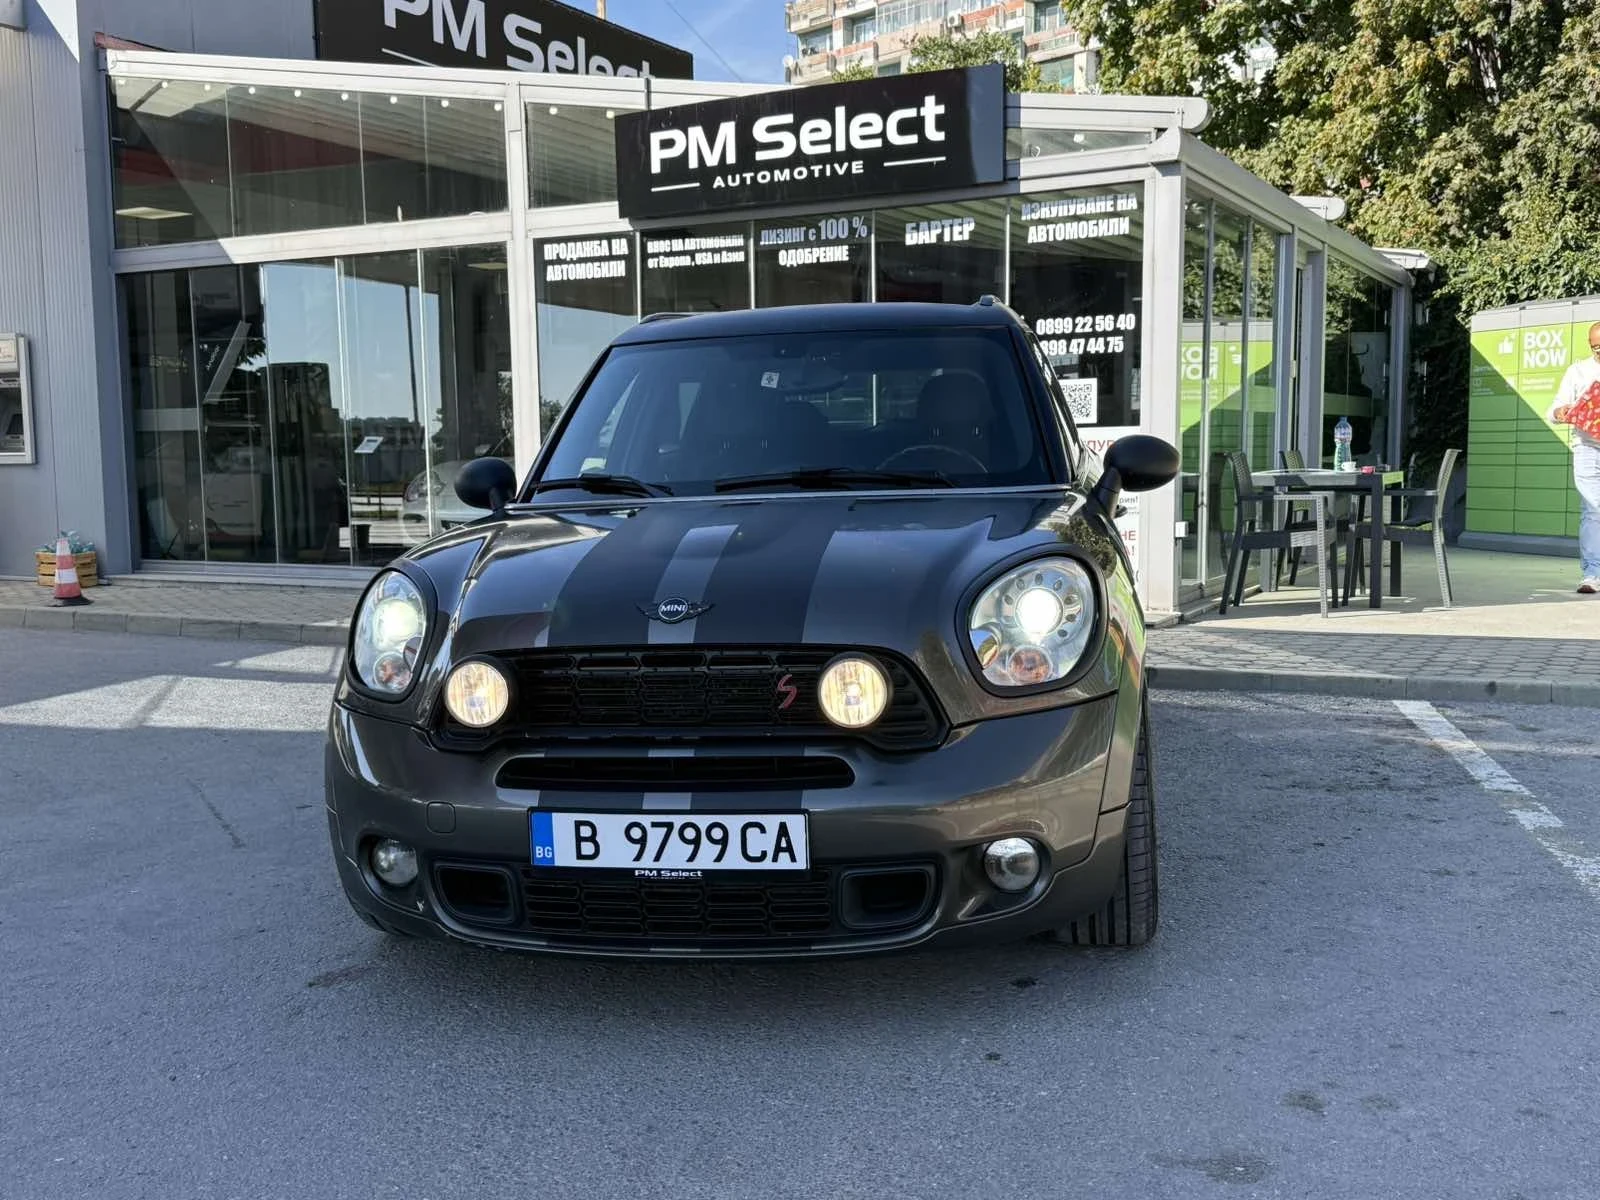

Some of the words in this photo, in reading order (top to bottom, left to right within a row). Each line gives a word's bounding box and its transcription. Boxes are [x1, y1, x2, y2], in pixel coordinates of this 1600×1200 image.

[650, 121, 736, 174] PM
[752, 95, 946, 161] Select
[712, 160, 865, 189] AUTOMOTIVE
[1021, 194, 1114, 221] ИЗКУПУВАНЕ
[1116, 192, 1138, 211] НА
[760, 226, 807, 246] ЛИЗИНГ
[818, 217, 849, 240] 100
[852, 215, 868, 239] %
[905, 217, 975, 246] БАРТЕР
[1027, 216, 1130, 244] АВТОМОБИЛИ
[544, 239, 610, 261] ПРОДАЖБА
[611, 237, 629, 255] НА
[671, 238, 684, 252] НА
[684, 234, 744, 250] АВТОМОБИЛИ
[695, 251, 713, 265] USA
[721, 250, 745, 263] Азия
[778, 245, 850, 268] ОДОБРЕНИЕ
[546, 260, 626, 282] АВТОМОБИЛИ
[1036, 317, 1073, 336] 0899
[1075, 316, 1093, 333] 22
[1095, 315, 1114, 332] 56
[1117, 313, 1136, 331] 40
[1039, 339, 1067, 357] 898
[1069, 338, 1086, 355] 47
[1087, 337, 1105, 354] 44
[1107, 336, 1124, 353] 75
[1524, 330, 1563, 349] BOX
[1523, 348, 1566, 368] NOW
[661, 604, 686, 612] MINI
[777, 674, 797, 710] S
[535, 846, 552, 858] BG
[574, 820, 601, 861] B
[624, 821, 729, 862] 9799
[740, 821, 797, 863] CA
[634, 869, 658, 877] PM
[660, 869, 703, 877] Select
